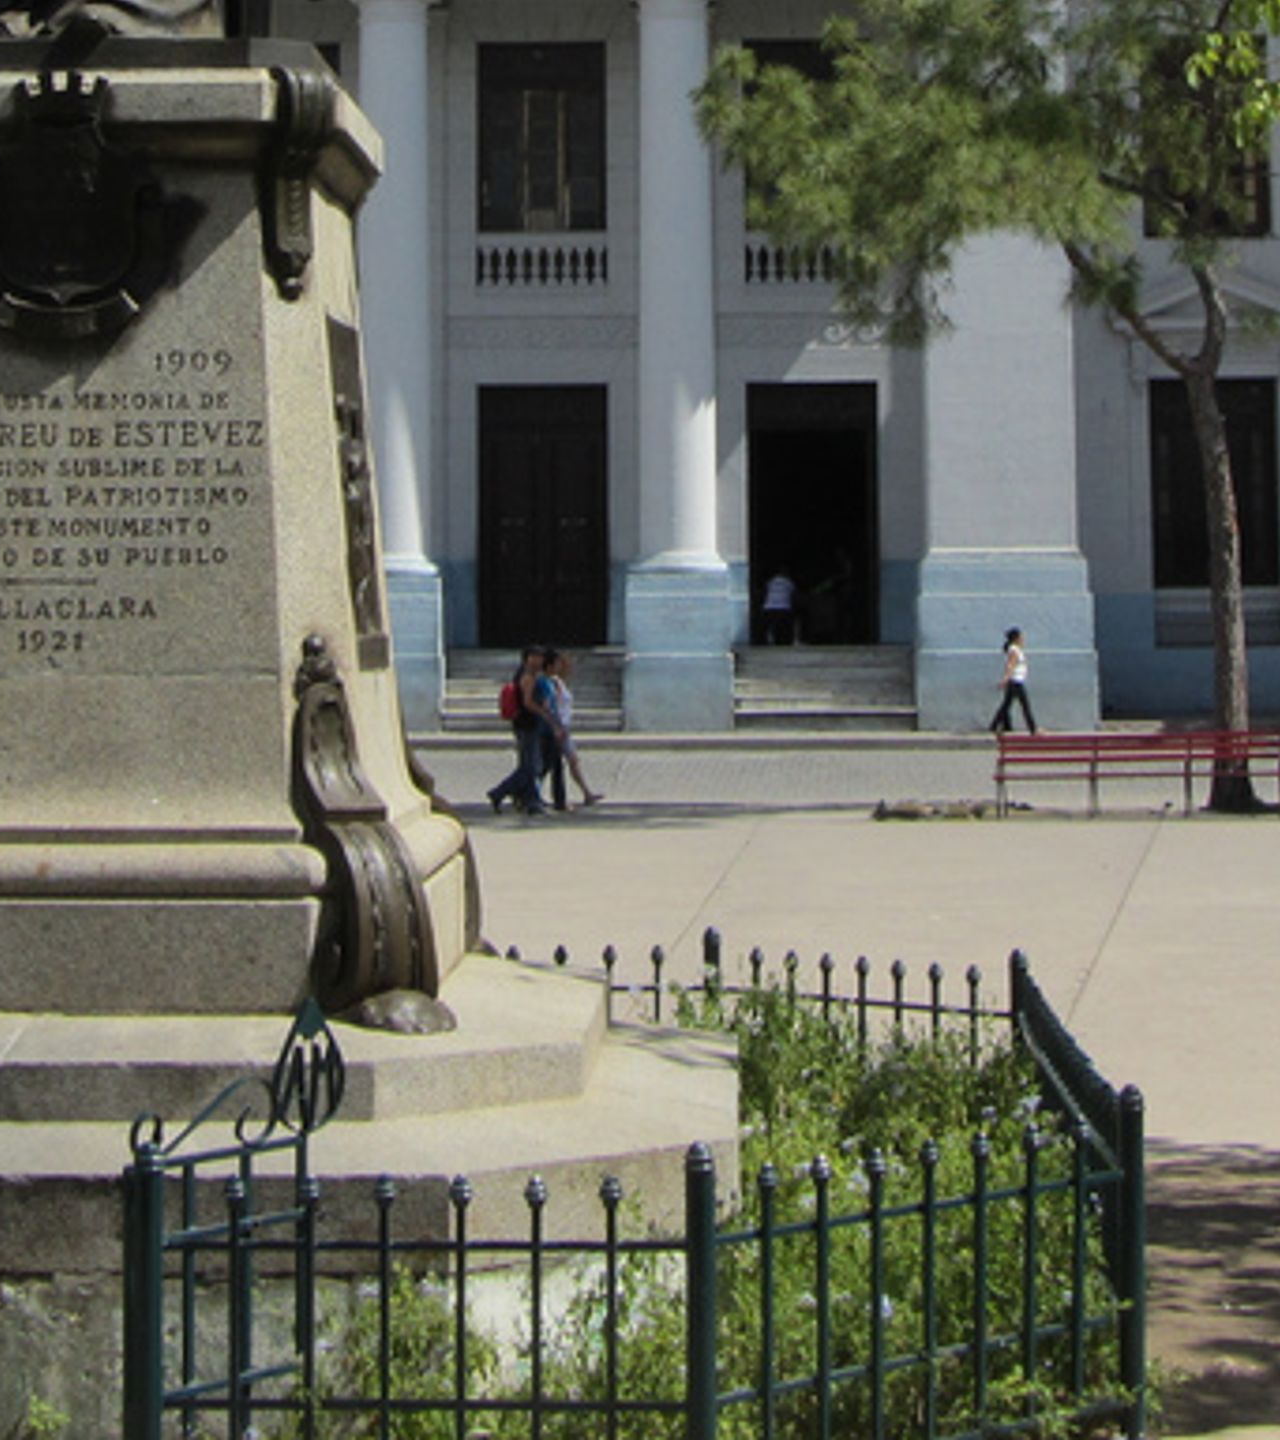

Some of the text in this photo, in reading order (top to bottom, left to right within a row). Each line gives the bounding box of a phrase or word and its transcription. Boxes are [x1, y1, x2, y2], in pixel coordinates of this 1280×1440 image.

[154, 348, 234, 376] 1909
[74, 392, 190, 410] MEMORIA
[200, 391, 230, 410] DE
[69, 426, 102, 448] DE
[114, 419, 264, 448] ESTEVEZ
[56, 458, 166, 478] SUBLIME
[174, 458, 206, 477] DE
[215, 458, 245, 477] LA
[5, 486, 51, 508] DEL
[64, 485, 249, 507] PATRIOTISMO
[49, 516, 212, 537] MONUMENTO
[32, 547, 66, 567] DE
[77, 547, 111, 566] SU
[125, 546, 230, 567] PUEBLO
[17, 629, 84, 654] 1921
